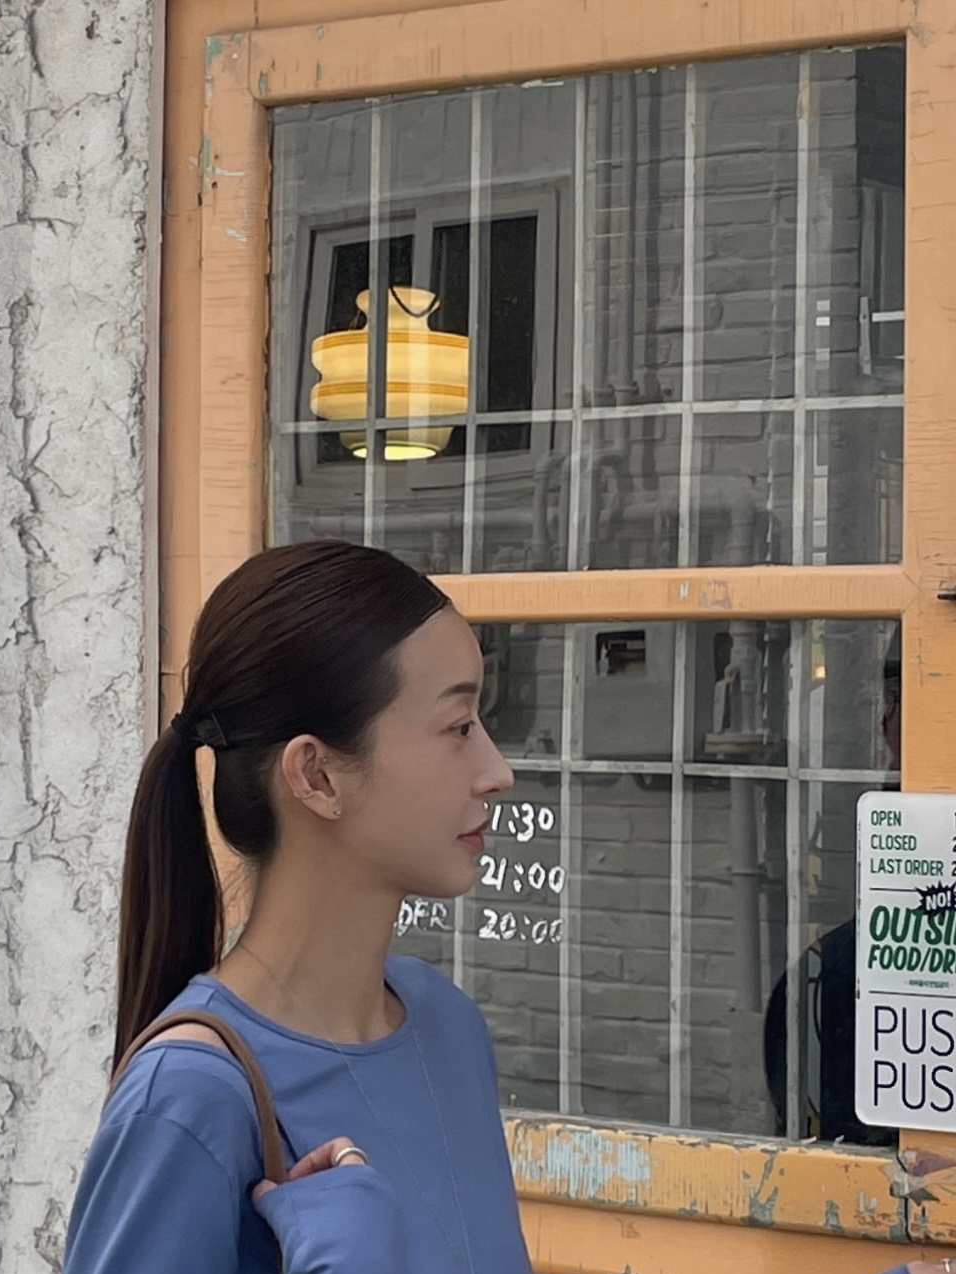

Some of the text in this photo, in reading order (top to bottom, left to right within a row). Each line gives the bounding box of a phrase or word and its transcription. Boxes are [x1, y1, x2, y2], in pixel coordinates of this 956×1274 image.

[483, 802, 554, 842] 1:30
[870, 810, 902, 827] OPEN
[870, 834, 917, 851] CLOSED
[479, 855, 565, 893] 21:00
[869, 858, 902, 874] LAST
[904, 859, 944, 876] ORDER
[925, 890, 952, 911] NO!
[869, 904, 956, 945] OUTSI
[868, 944, 956, 975] FOOD/DR
[874, 1005, 955, 1057] PUS
[873, 1060, 955, 1113] PUS
